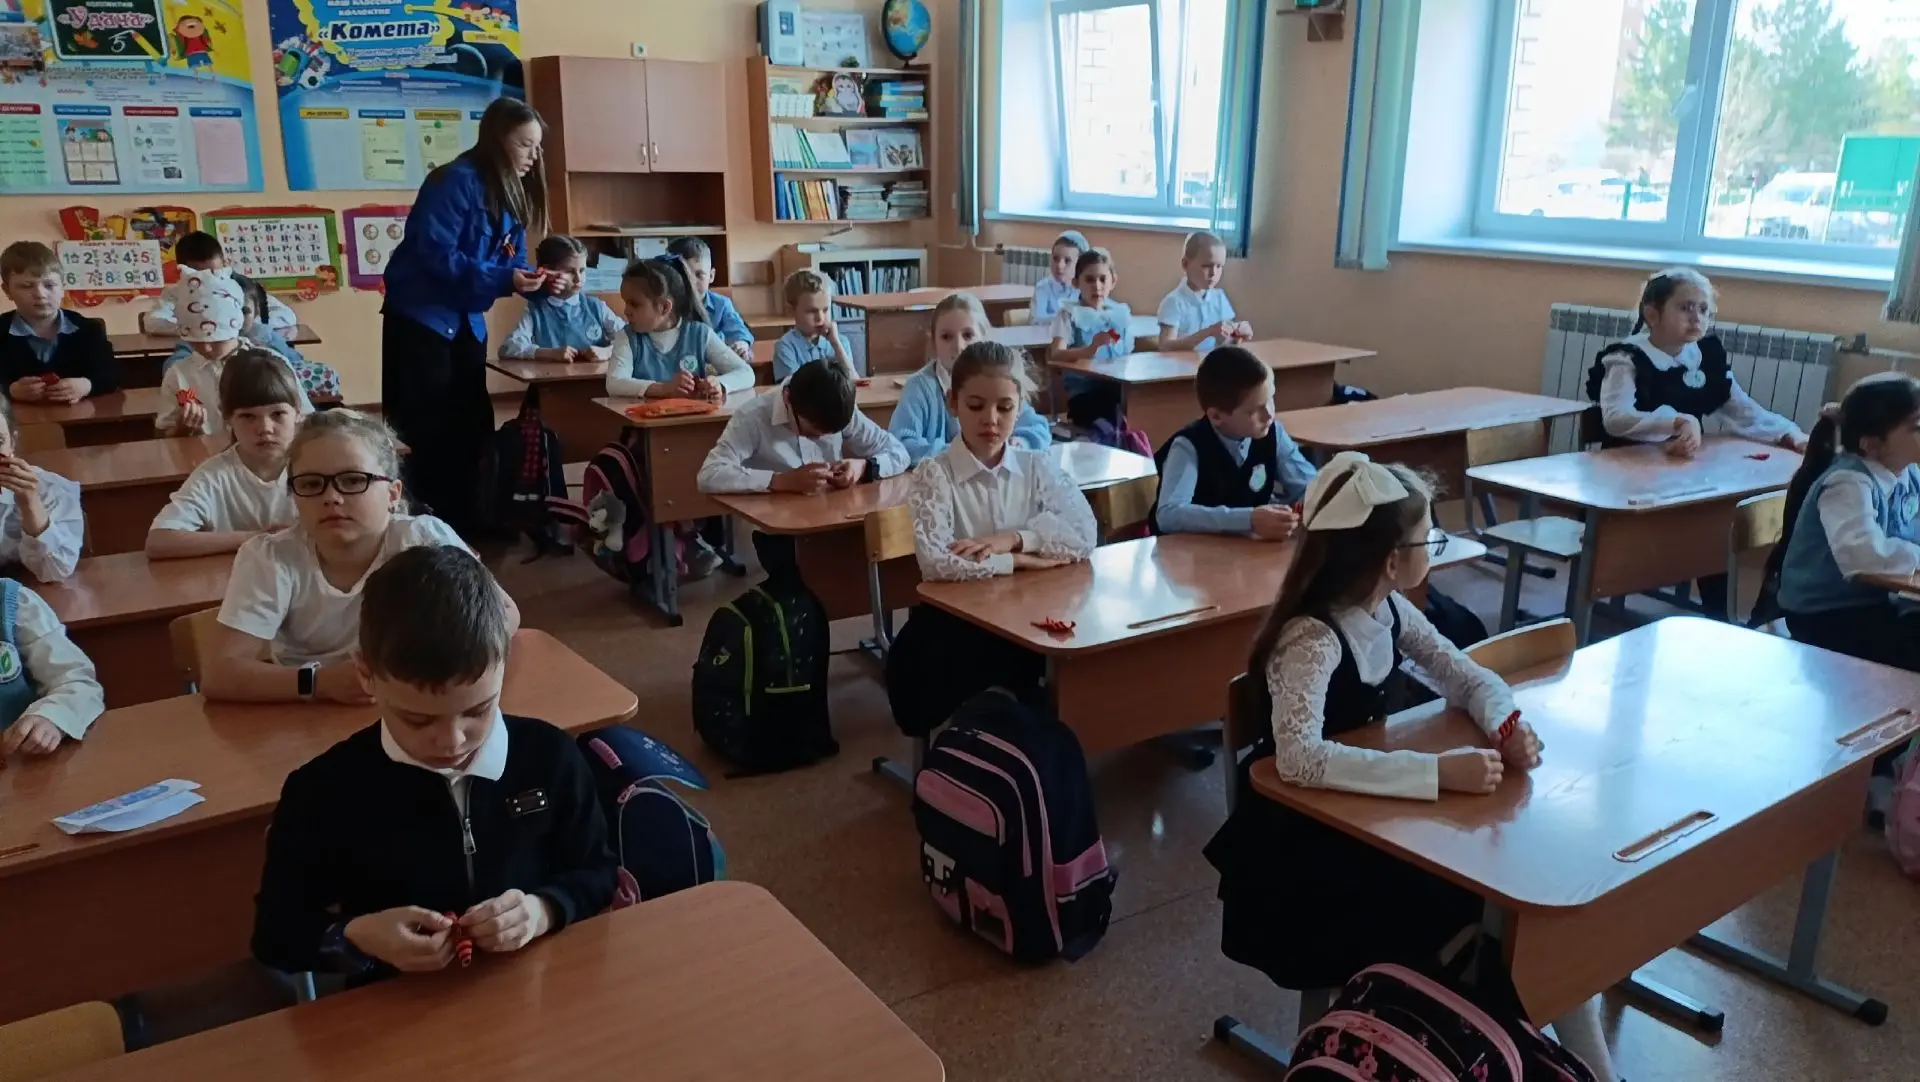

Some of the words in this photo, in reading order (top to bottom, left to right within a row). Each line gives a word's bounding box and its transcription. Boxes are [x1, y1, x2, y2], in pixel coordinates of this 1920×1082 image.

[318, 22, 441, 40] «Комета»
[63, 252, 70, 265] 1
[83, 252, 93, 265] 2
[103, 252, 113, 264] 3
[123, 251, 132, 264] 4
[141, 251, 150, 264] 5
[66, 272, 76, 285] 6
[105, 271, 114, 284] 8
[124, 271, 134, 283] 9
[142, 270, 156, 283] 10
